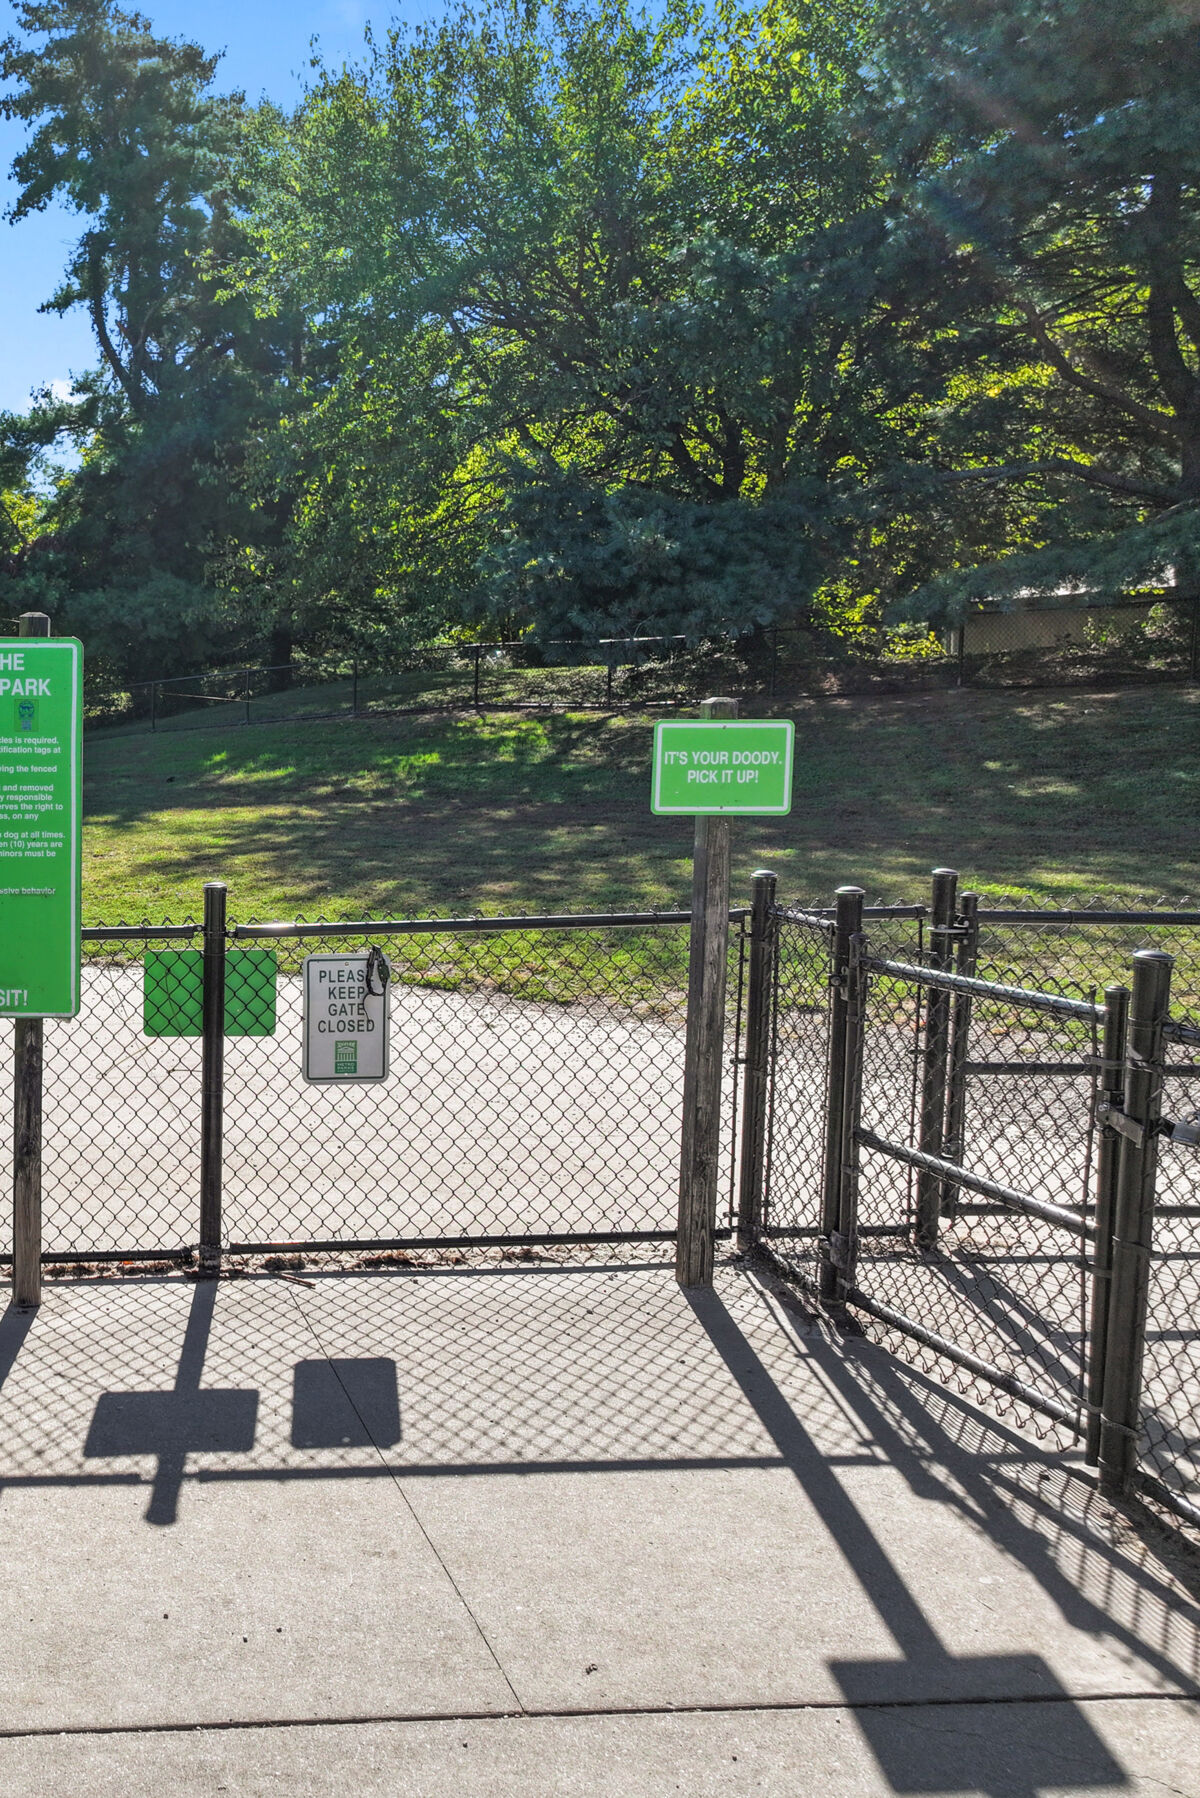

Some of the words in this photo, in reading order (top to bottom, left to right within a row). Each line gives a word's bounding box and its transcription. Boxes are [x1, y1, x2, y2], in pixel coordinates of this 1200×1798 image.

[0, 678, 51, 696] PARK
[24, 736, 58, 746] required.
[34, 745, 52, 755] tags
[664, 752, 688, 765] IT'S
[692, 752, 729, 765] YOUR
[732, 751, 782, 765] DOODY.
[687, 770, 718, 784] PICK
[721, 770, 733, 783] IT
[736, 770, 759, 784] UP!
[6, 793, 53, 802] responsible
[34, 803, 53, 812] right
[3, 831, 19, 840] dog
[10, 840, 25, 849] (10)
[27, 841, 48, 849] years
[24, 849, 44, 857] must
[319, 970, 374, 983] PLEAS
[328, 986, 365, 1000] KEEP
[328, 1003, 365, 1016] GATE
[318, 1020, 375, 1033] CLOSED
